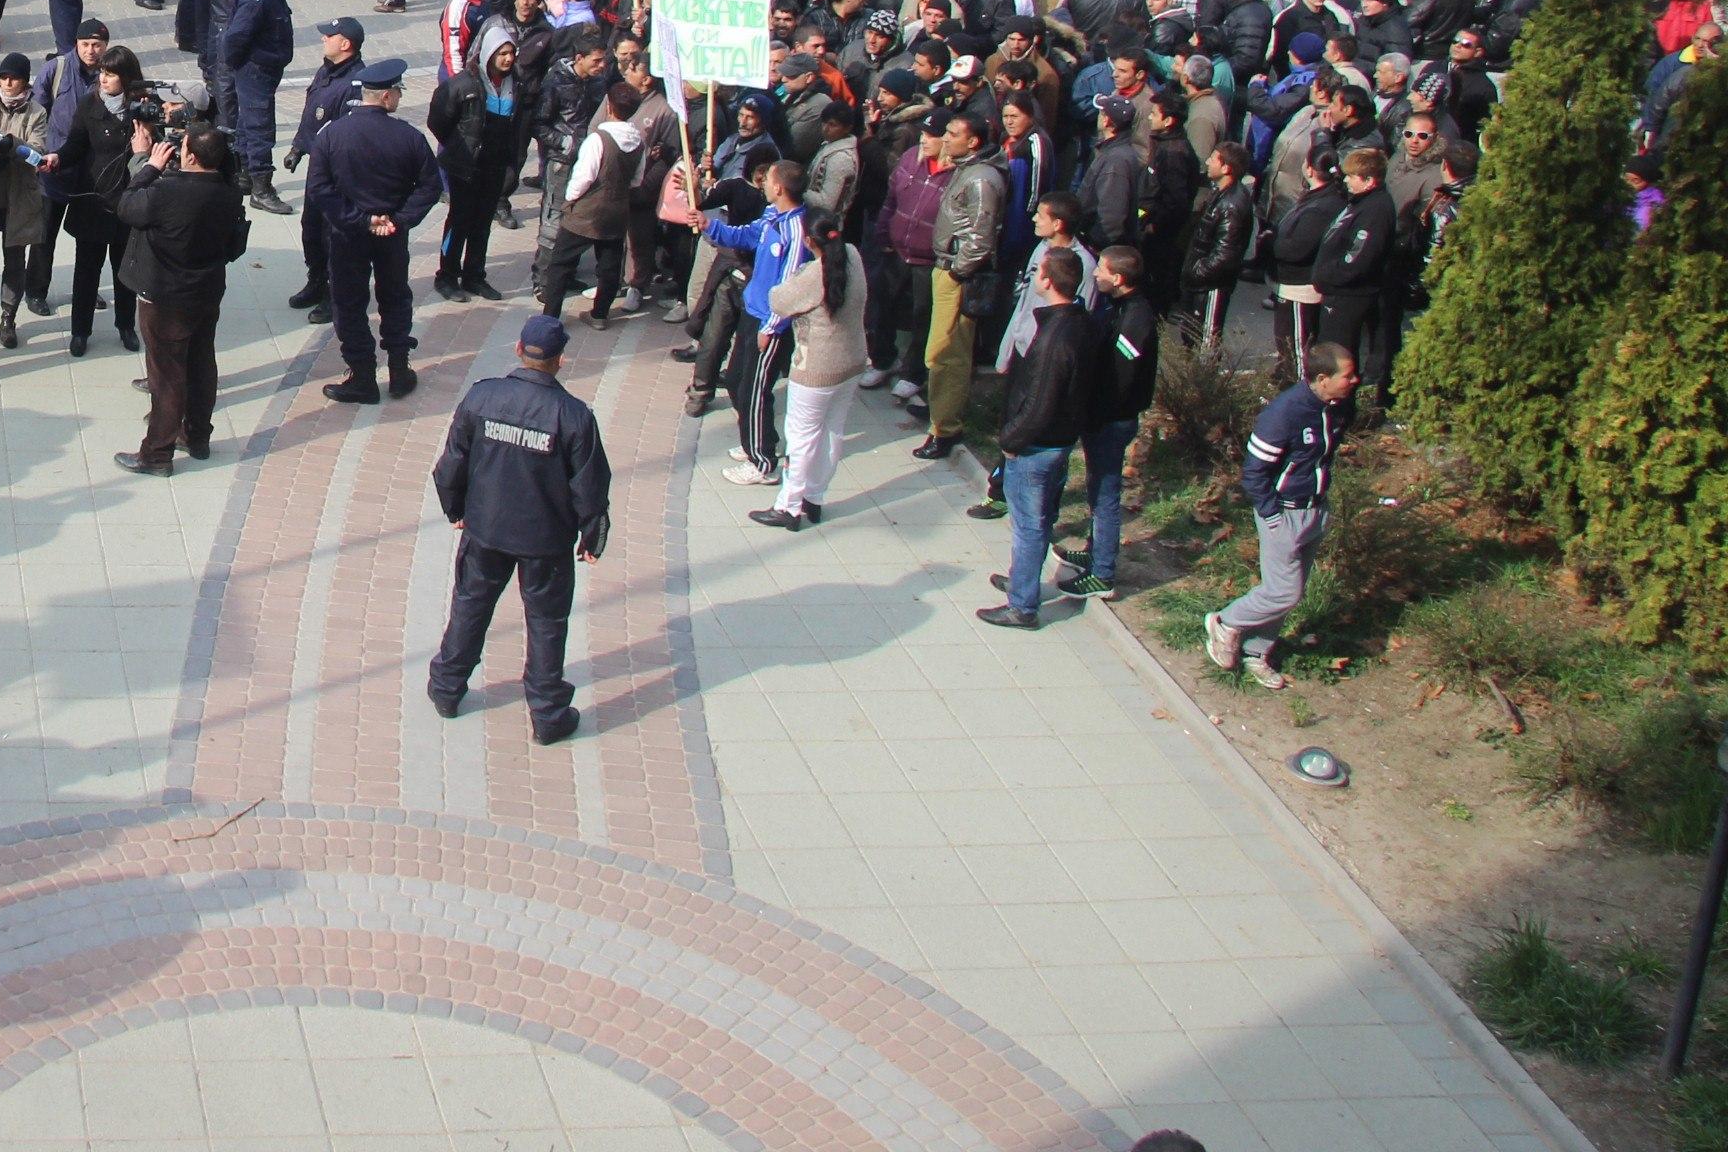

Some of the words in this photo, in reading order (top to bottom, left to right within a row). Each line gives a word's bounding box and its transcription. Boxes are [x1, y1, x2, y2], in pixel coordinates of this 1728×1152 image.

[484, 420, 523, 446] SECURITY
[522, 428, 551, 452] POLICE
[1303, 427, 1313, 444] 6
